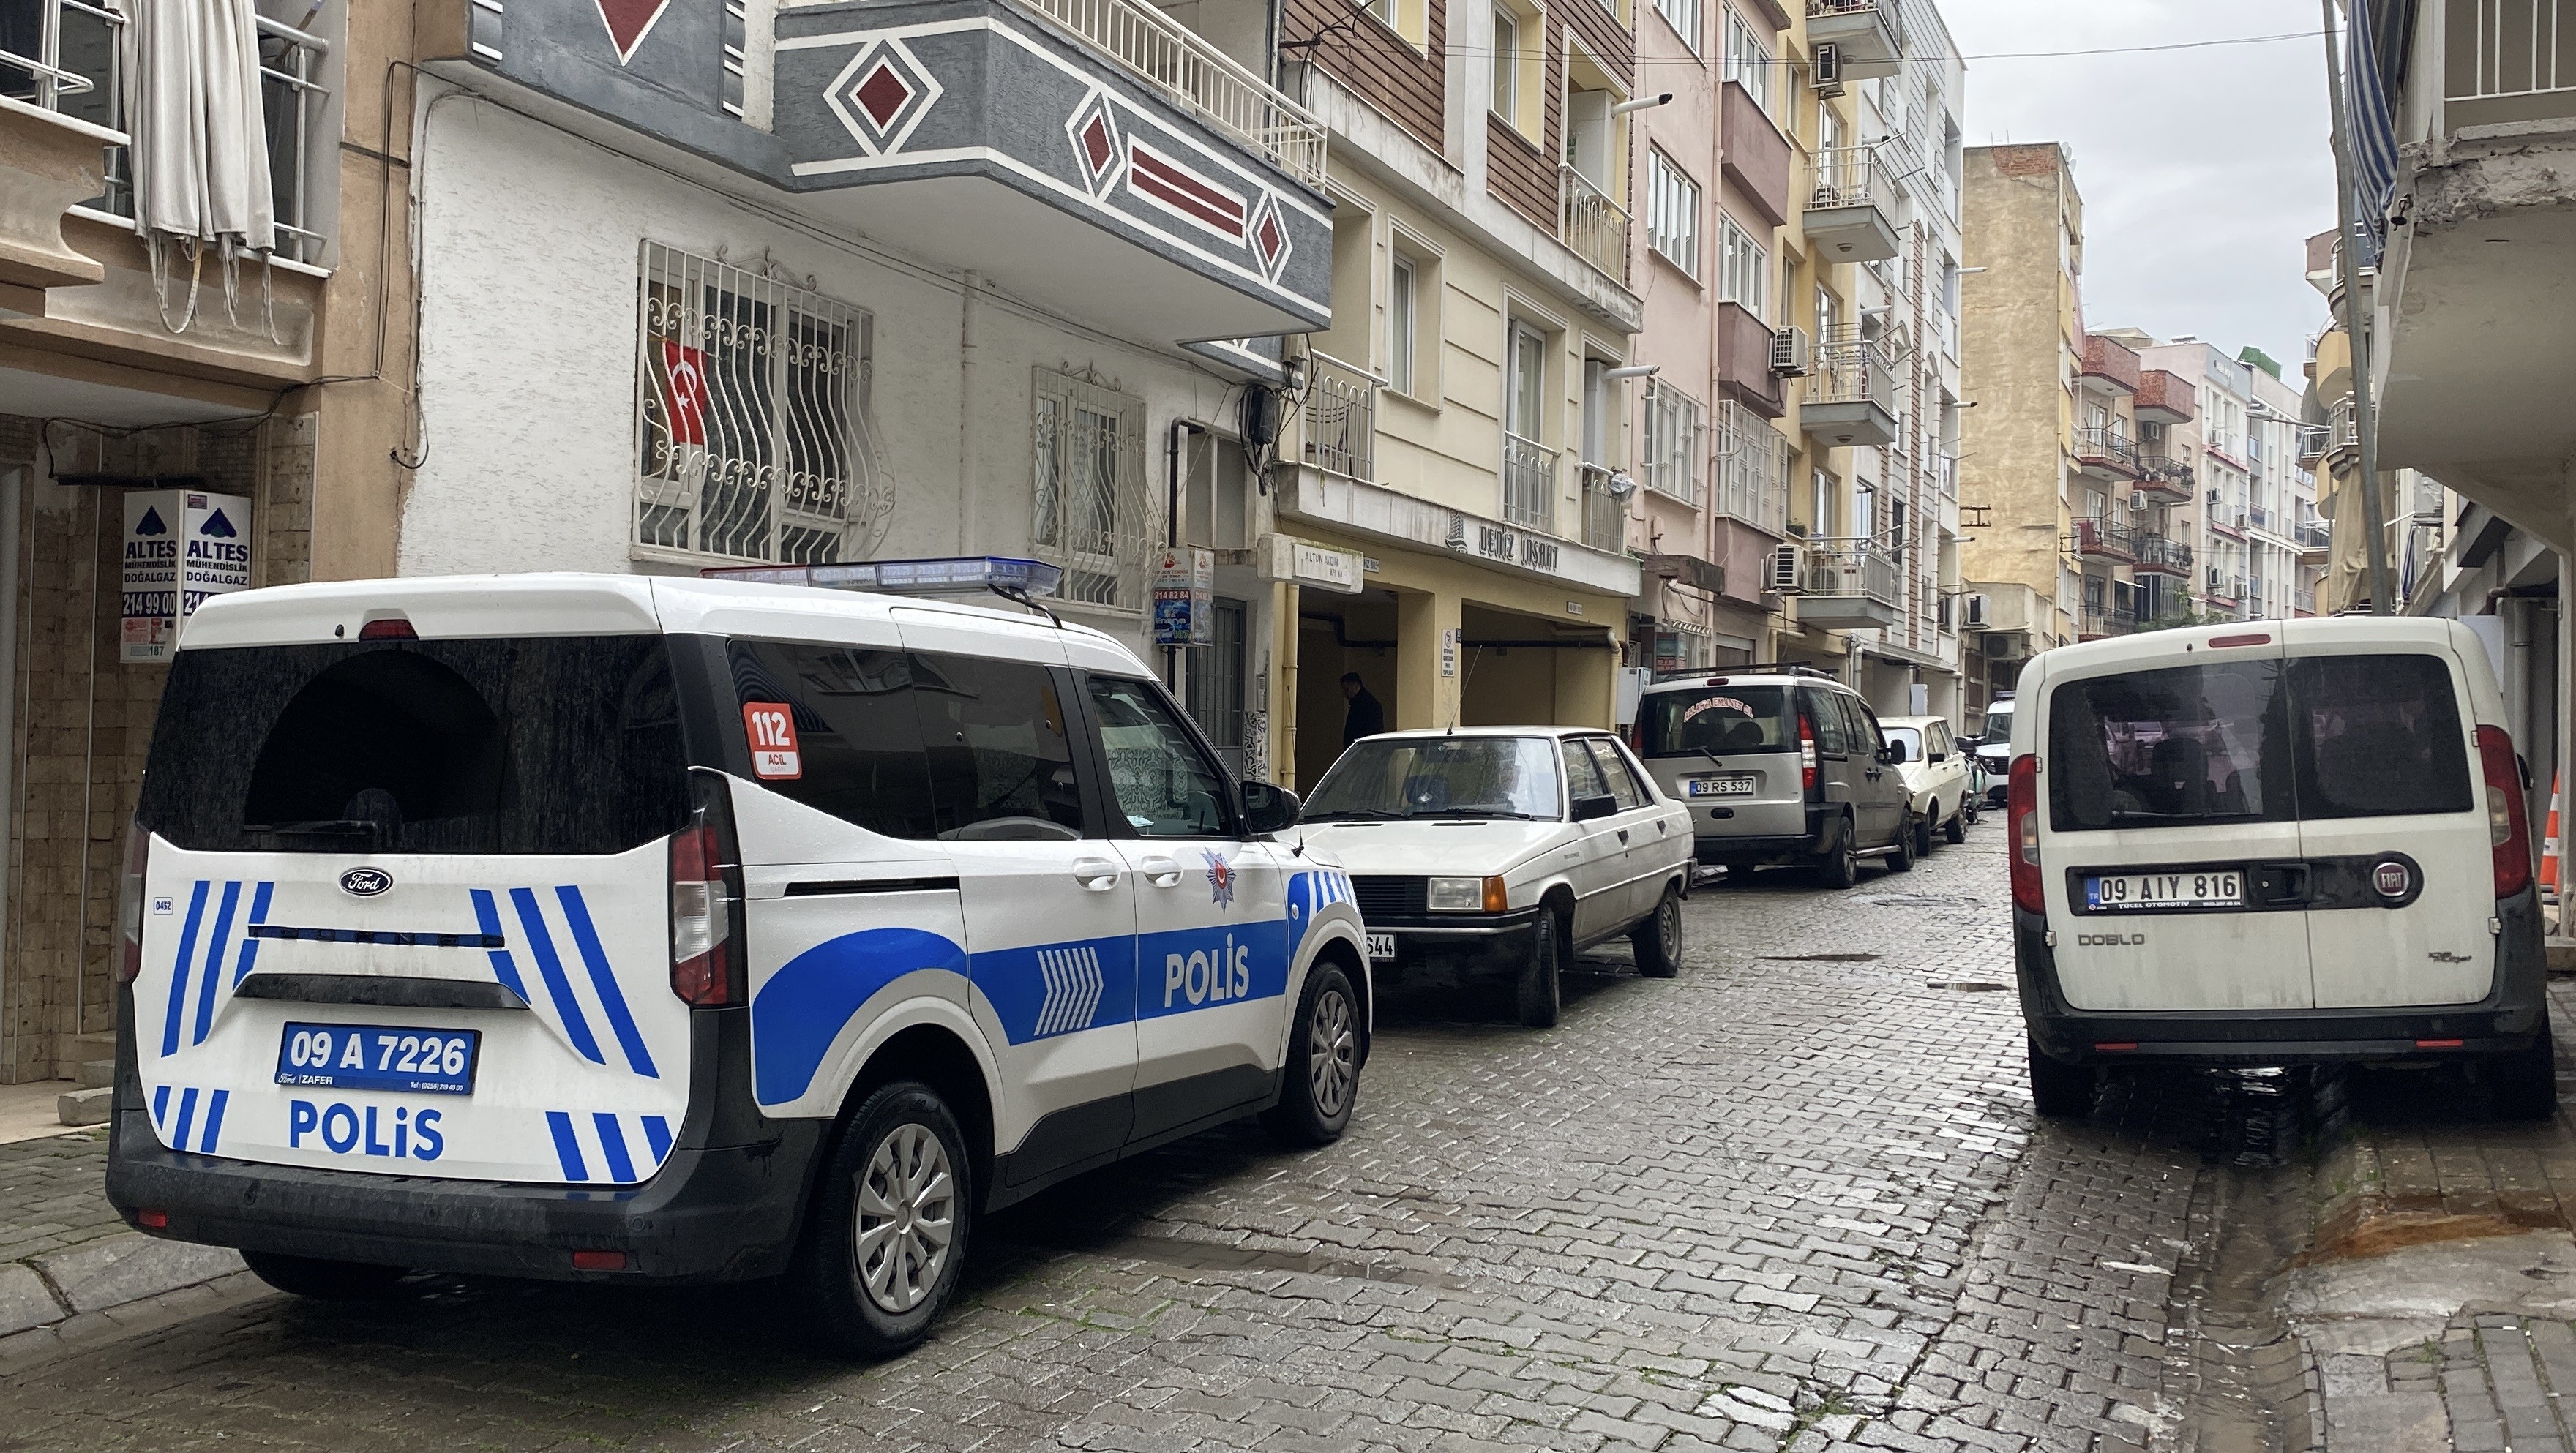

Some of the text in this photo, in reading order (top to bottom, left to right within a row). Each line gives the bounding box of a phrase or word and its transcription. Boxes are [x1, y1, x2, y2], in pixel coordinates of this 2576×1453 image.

[125, 540, 176, 559] ALTES
[187, 540, 248, 562] ALTES
[124, 559, 176, 569] MÜHENDİSLİK
[186, 559, 248, 572] MÜHENDİSLİK
[124, 571, 176, 582] DOĞALGAZ
[186, 571, 247, 585] DOĞALGAZ
[1154, 591, 1168, 599] 214
[123, 593, 176, 615] 214 99 00
[149, 646, 165, 656] 187
[752, 711, 790, 746] 112
[1696, 782, 1709, 792] 09
[1712, 781, 1728, 792] RS
[1731, 781, 1751, 792] 537
[348, 872, 380, 890] Ford
[2381, 872, 2403, 887] FIAT
[2101, 874, 2236, 901] 09 AIY 816
[156, 901, 171, 911] 0452
[2078, 933, 2145, 946] DOBLO
[1164, 932, 1250, 1008] POLİS
[291, 1031, 467, 1075] 09 A 7226
[278, 1073, 333, 1085] Ford ZAFER
